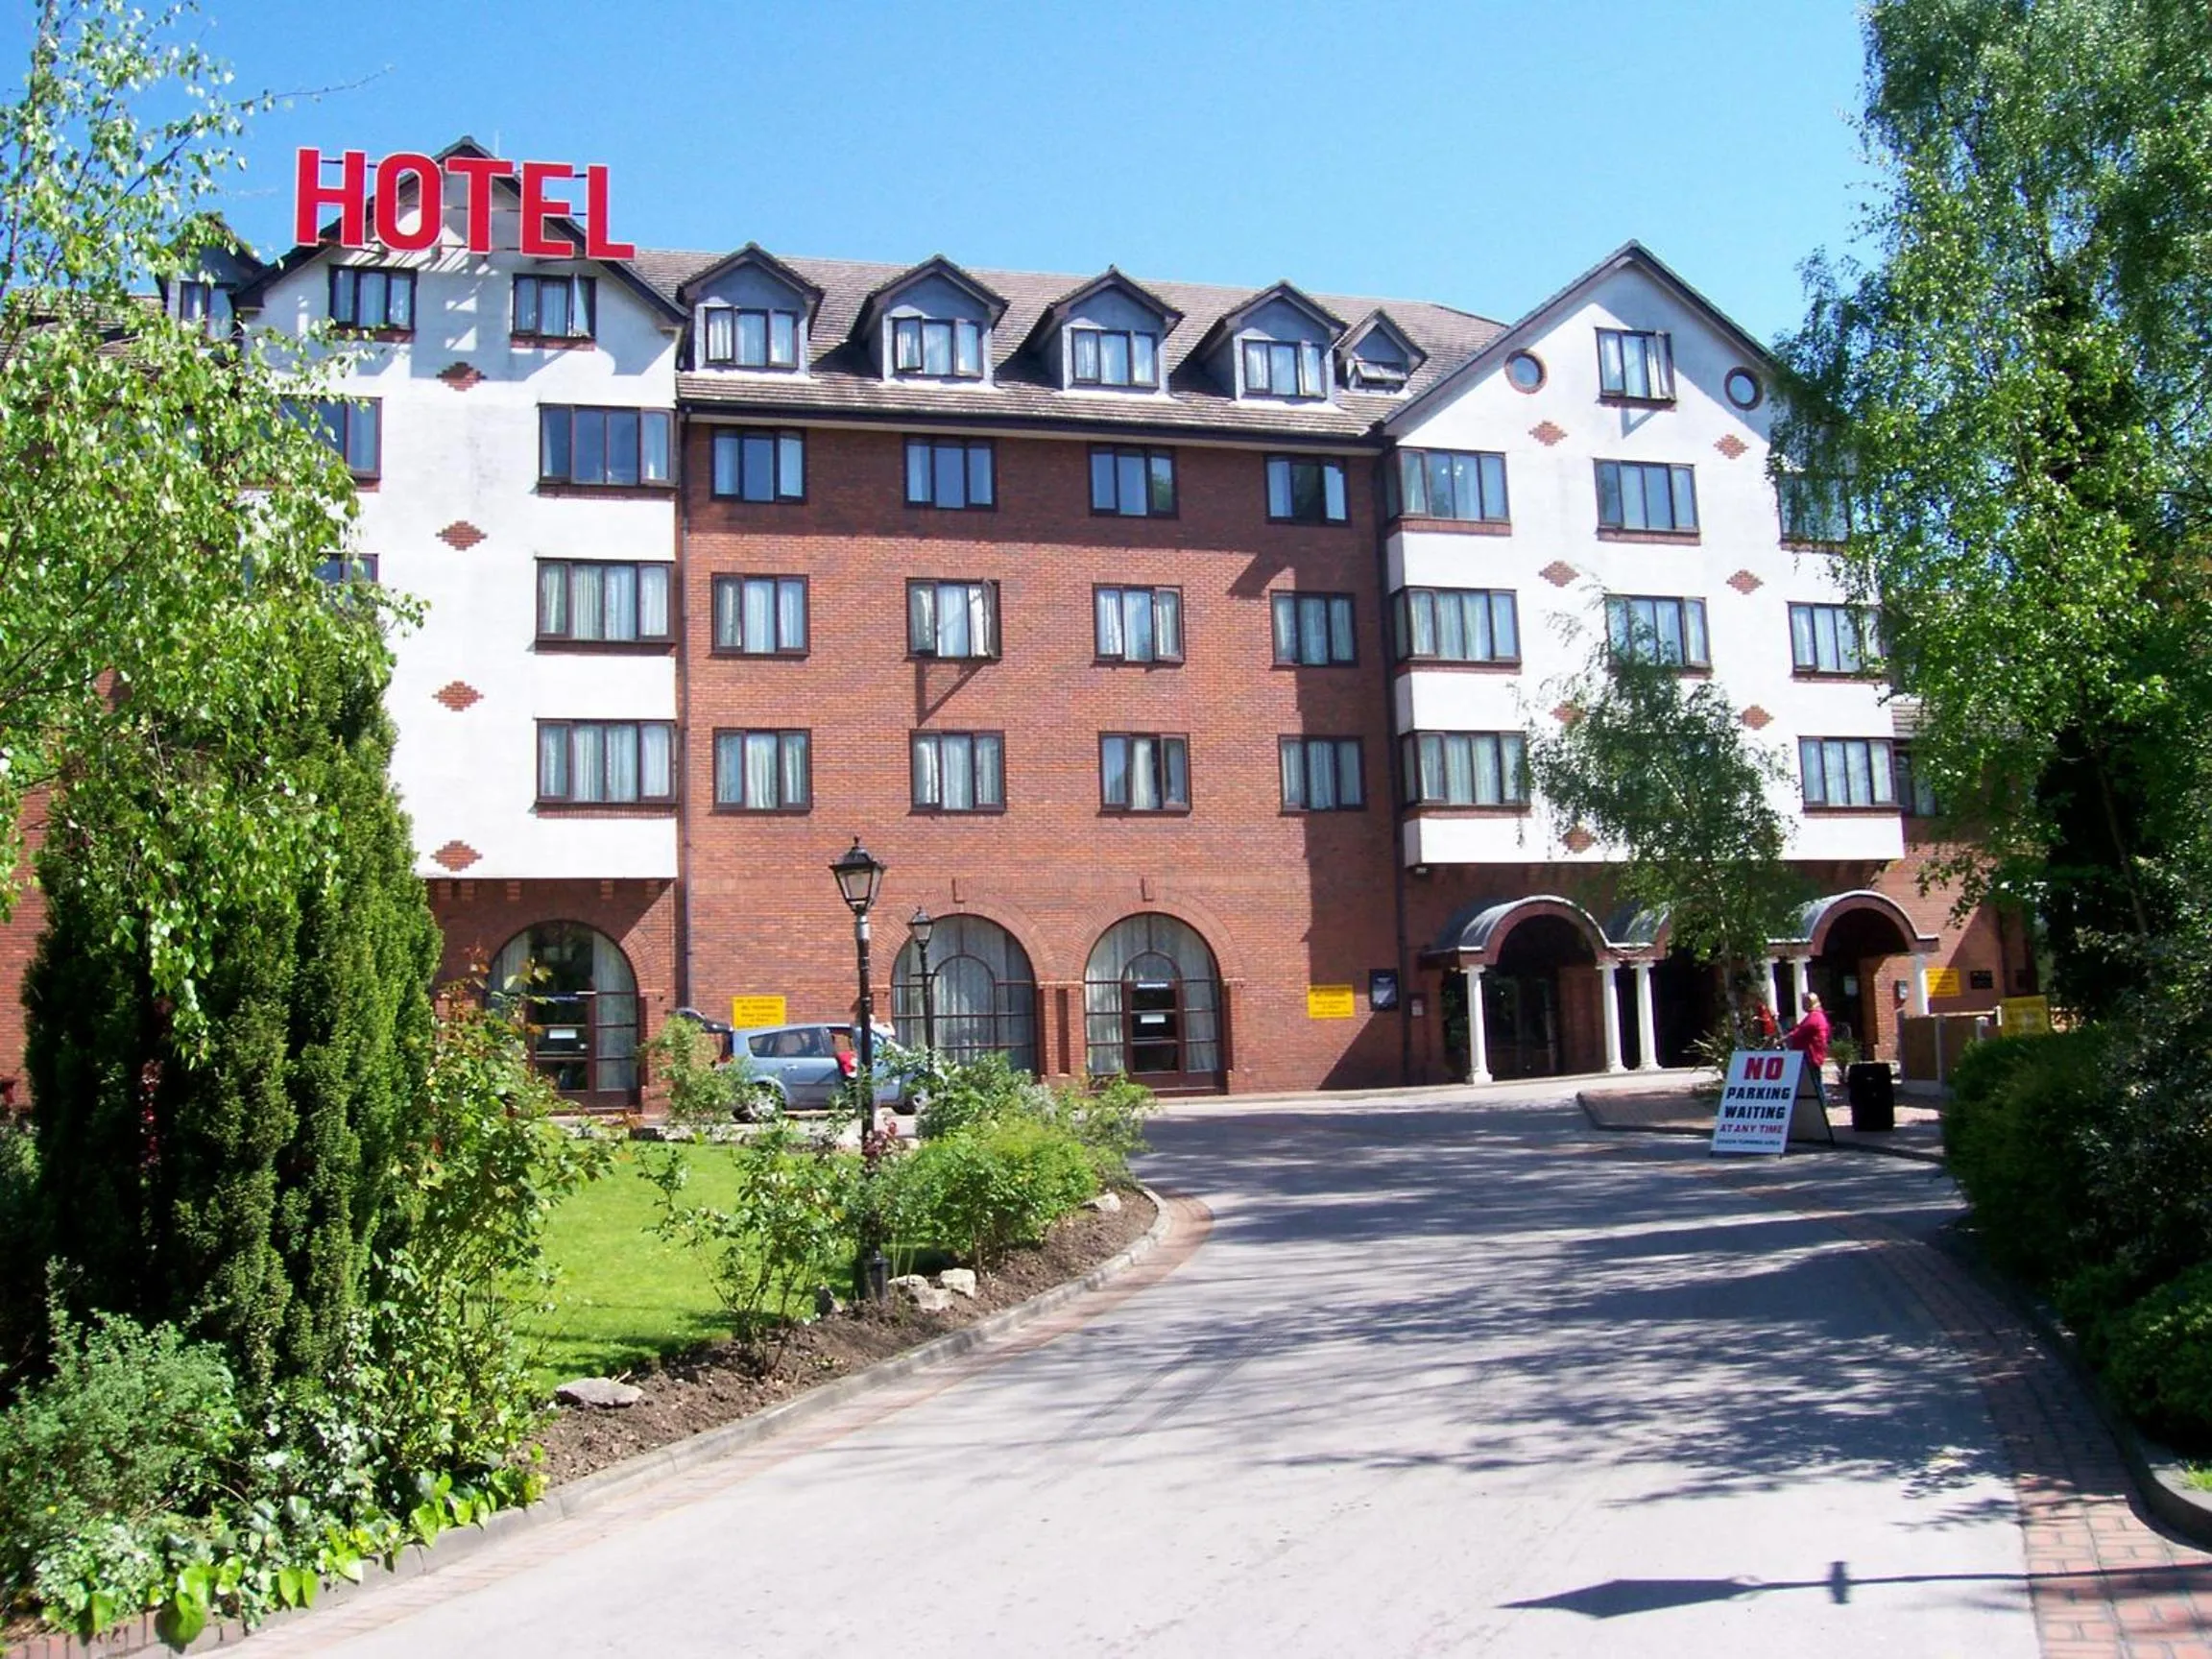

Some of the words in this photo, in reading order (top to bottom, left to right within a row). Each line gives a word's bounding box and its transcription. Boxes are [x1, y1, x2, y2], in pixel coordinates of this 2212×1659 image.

[294, 146, 636, 262] HOTEL
[1743, 1057, 1784, 1080] NO
[1726, 1087, 1791, 1099] PARKING
[1724, 1106, 1786, 1118] WAITING
[1719, 1124, 1733, 1133] AT
[1734, 1124, 1756, 1134] ANY
[1759, 1124, 1783, 1134] TIME
